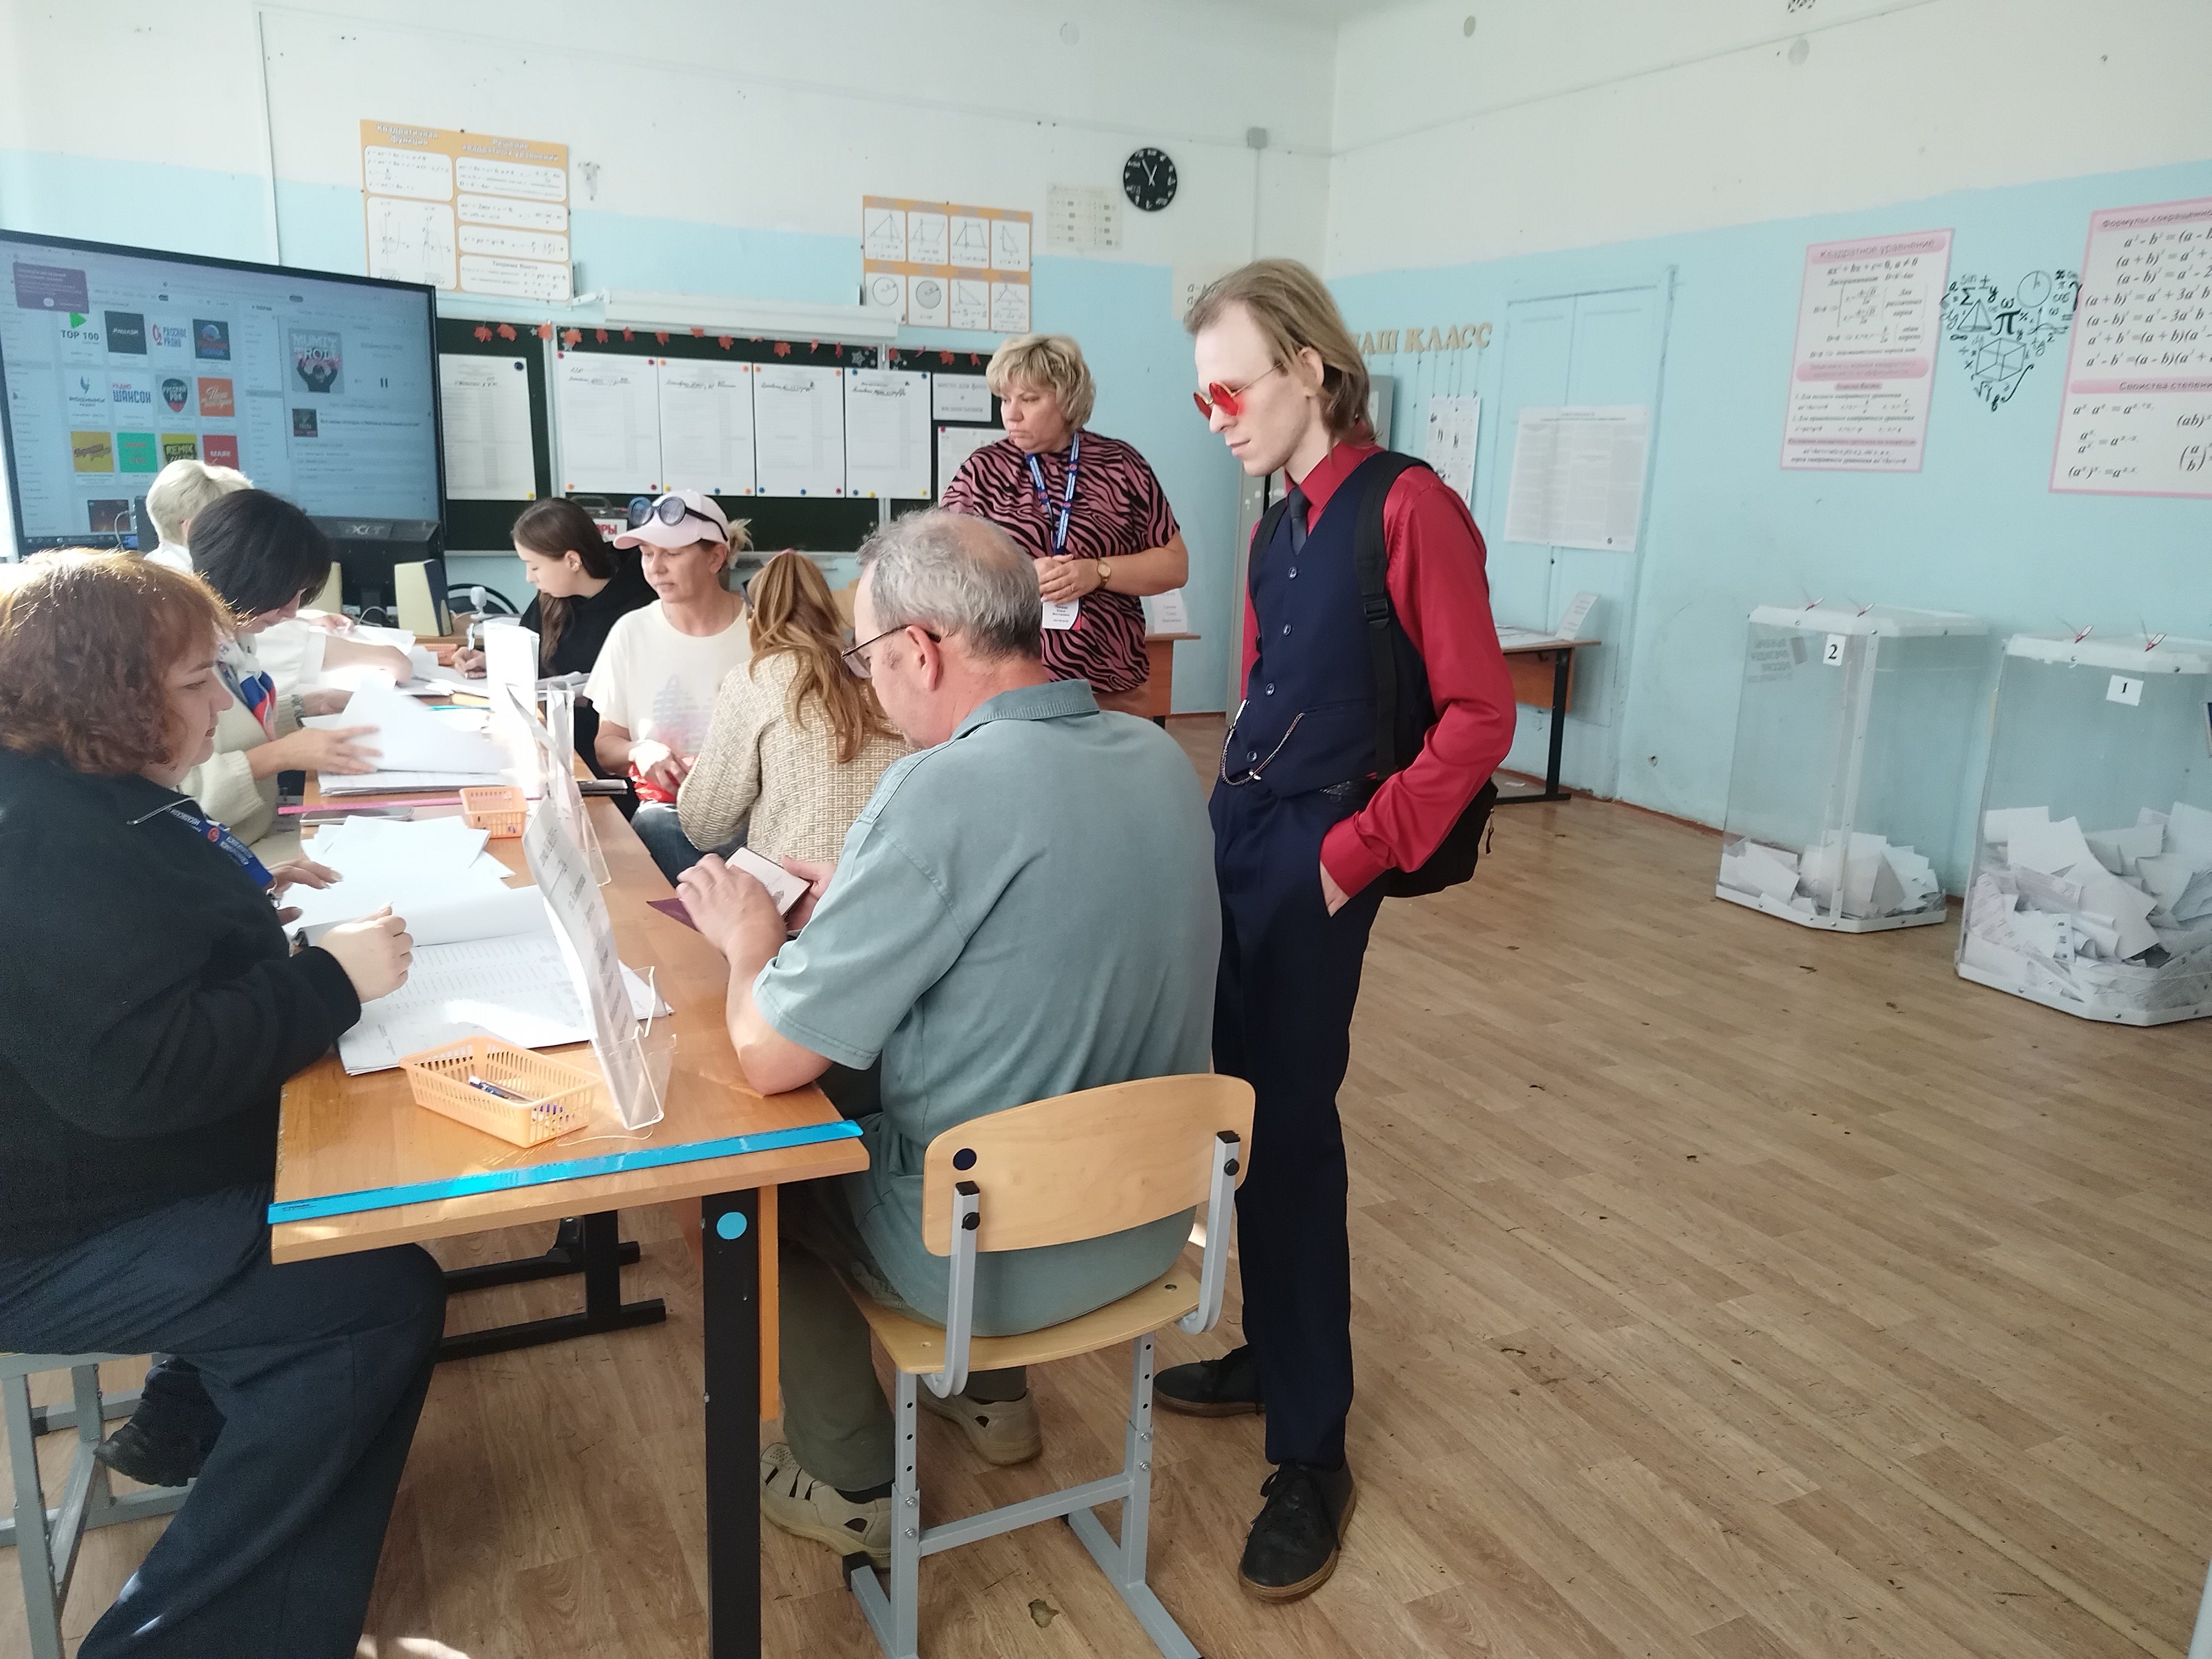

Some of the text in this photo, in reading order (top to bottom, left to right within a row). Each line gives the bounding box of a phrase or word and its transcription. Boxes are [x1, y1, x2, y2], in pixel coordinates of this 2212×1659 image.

[61, 329, 100, 342] TOP 100
[1403, 322, 1493, 353] КЛАСС
[112, 388, 152, 404] ШАНСОН
[1827, 643, 1839, 660] 2
[2121, 681, 2128, 693] 1
